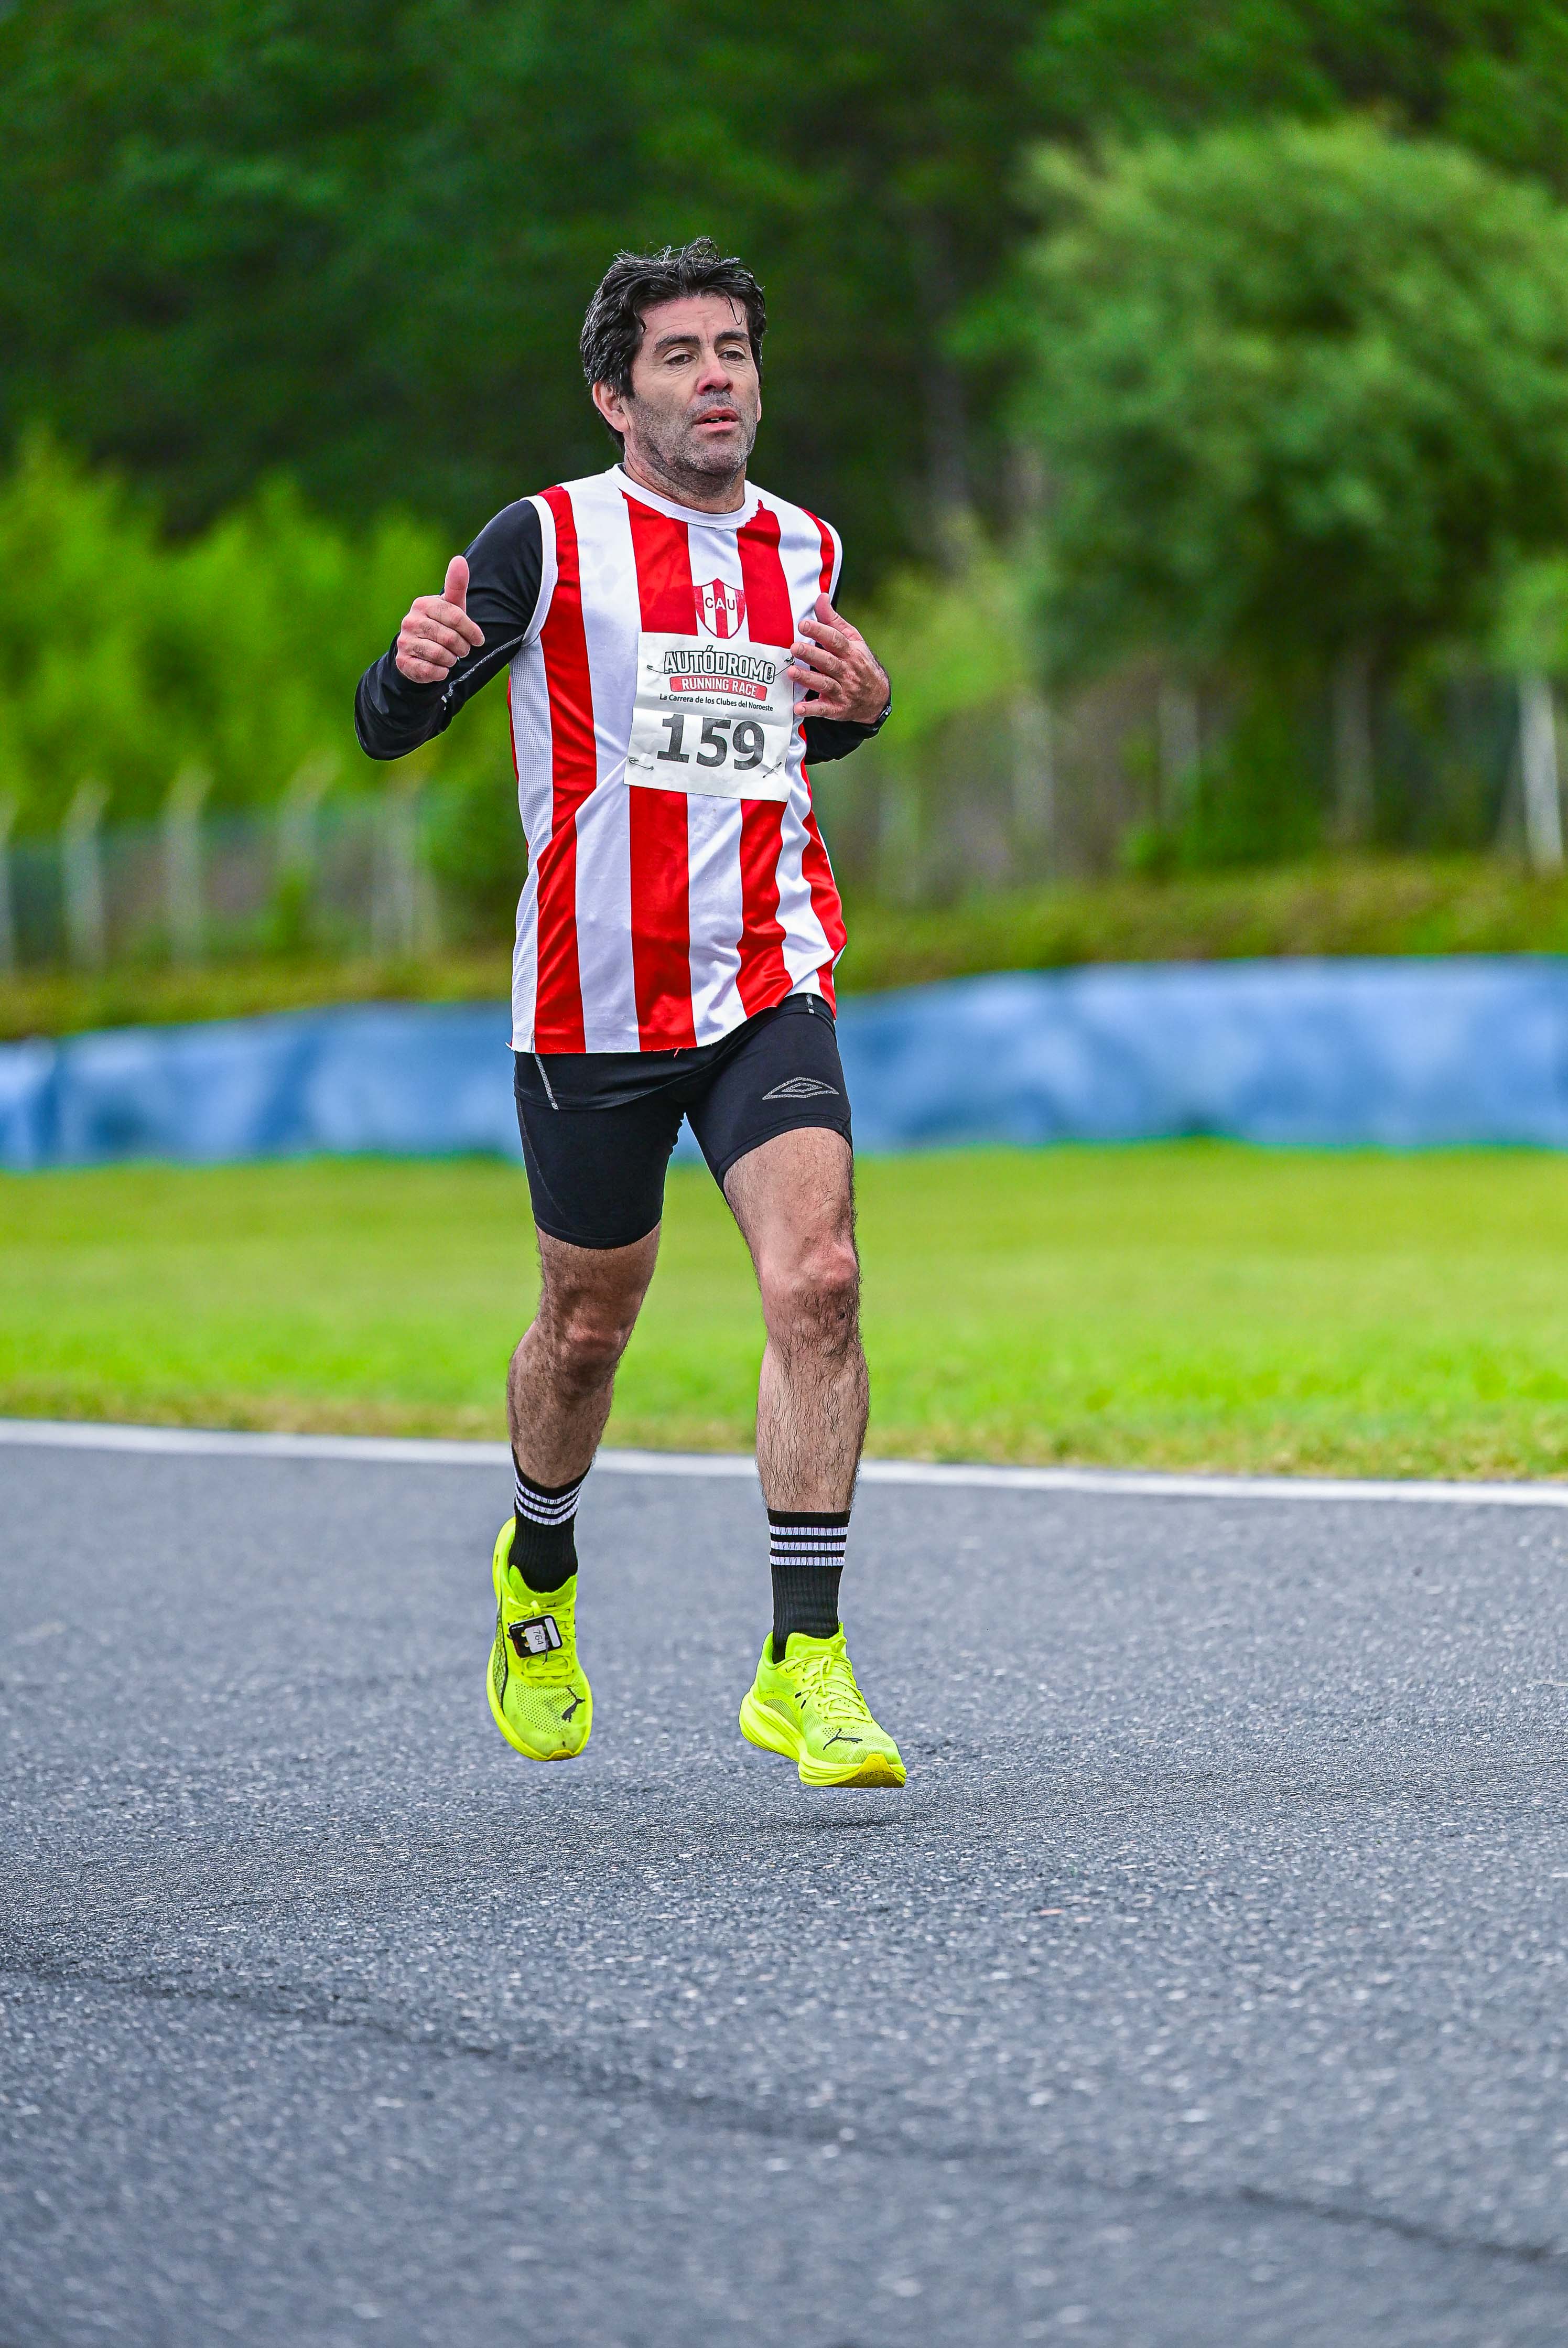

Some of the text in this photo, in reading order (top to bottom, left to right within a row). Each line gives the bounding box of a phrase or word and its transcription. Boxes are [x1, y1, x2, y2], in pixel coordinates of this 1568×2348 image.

[705, 597, 735, 610] CAU
[664, 645, 776, 684] AUTÓDROMO
[682, 677, 757, 697] RUNNING RACE
[668, 694, 694, 703] Carrera
[716, 698, 737, 706] Clubes
[749, 702, 773, 712] Noroeste
[657, 714, 765, 770] 159
